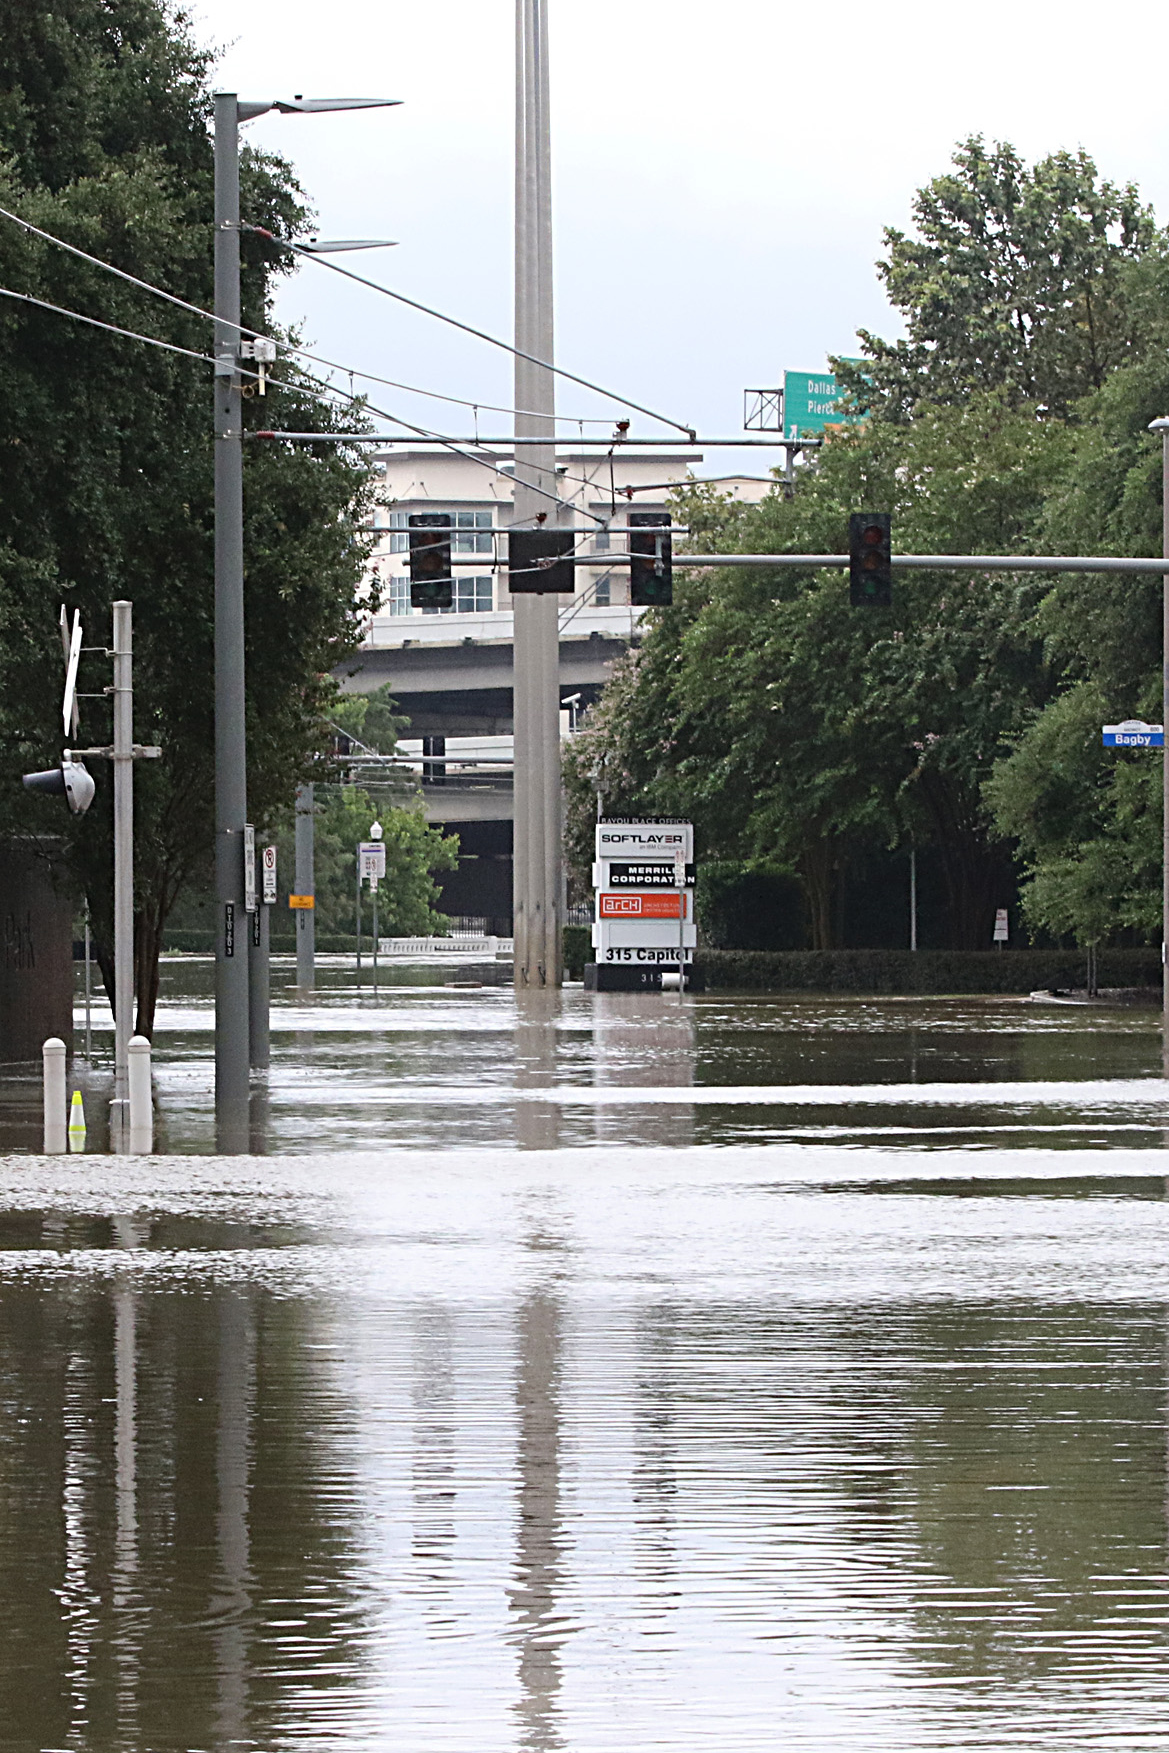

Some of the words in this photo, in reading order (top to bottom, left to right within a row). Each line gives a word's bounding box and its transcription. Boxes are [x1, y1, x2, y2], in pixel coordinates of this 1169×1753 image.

[808, 380, 836, 395] Dallas
[1115, 734, 1151, 746] Bagby
[601, 834, 683, 843] SOFTLAYER
[611, 875, 696, 883] CORPORATN
[605, 948, 632, 961] 315
[636, 947, 689, 964] Capitol
